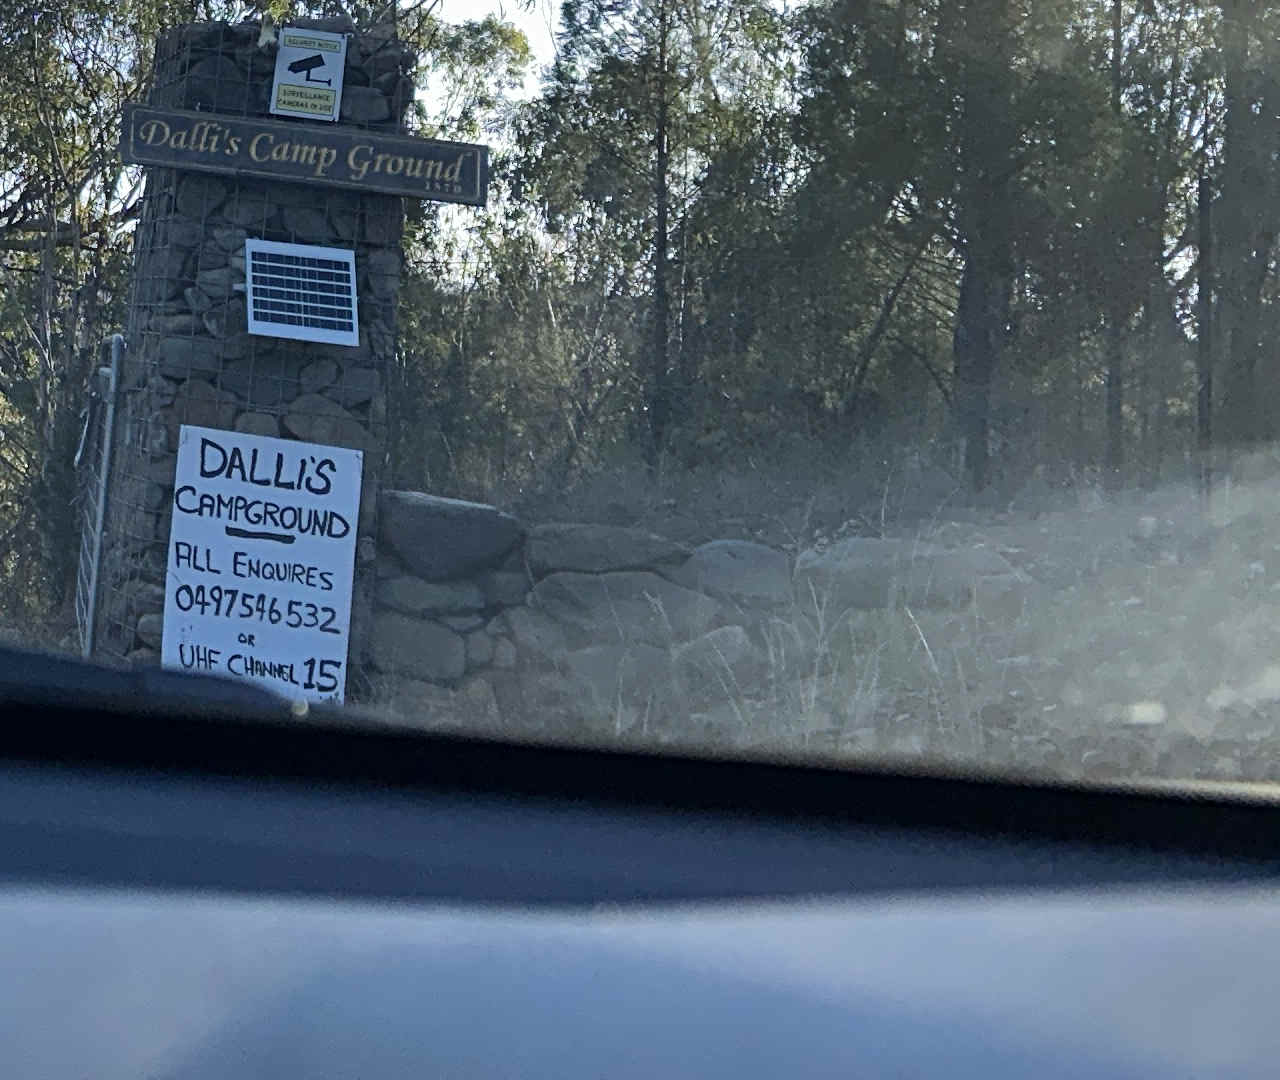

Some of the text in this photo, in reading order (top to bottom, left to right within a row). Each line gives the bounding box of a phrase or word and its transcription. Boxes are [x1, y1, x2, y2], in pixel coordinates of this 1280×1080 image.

[140, 119, 472, 182] Dalli's Camp Ground
[199, 437, 336, 495] DALLI'S
[175, 485, 350, 538] CAMPGROUND
[175, 541, 333, 591] ALL ENQUIRES
[175, 584, 341, 634] 0497546532
[238, 633, 255, 647] OR
[179, 643, 342, 692] UHF CHANNEL 15
